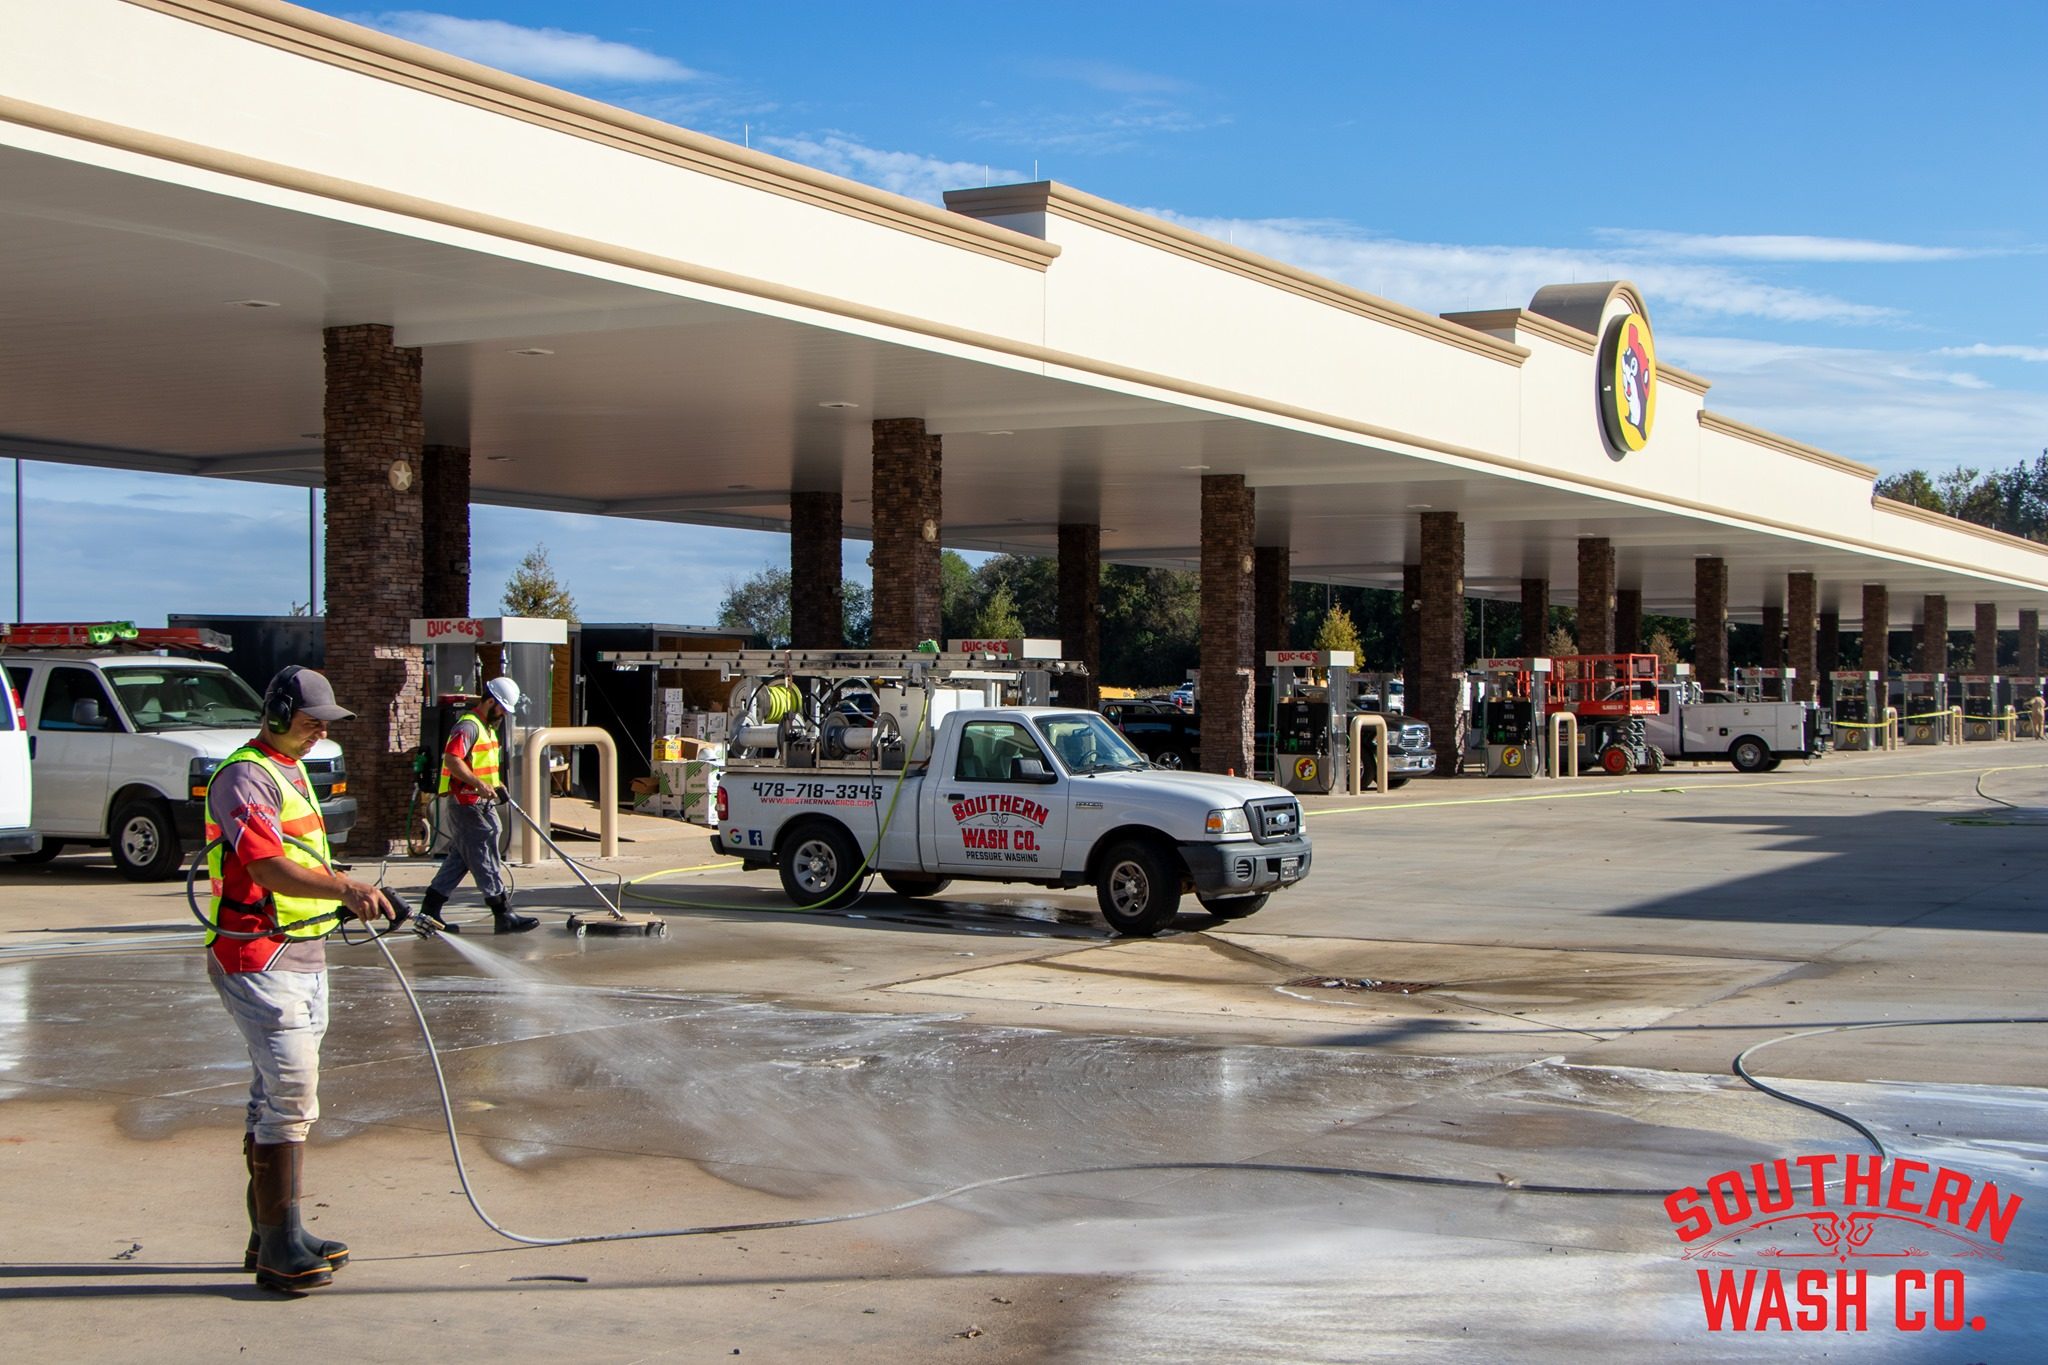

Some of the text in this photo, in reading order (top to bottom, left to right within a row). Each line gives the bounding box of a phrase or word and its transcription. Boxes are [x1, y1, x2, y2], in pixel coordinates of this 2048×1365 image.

[951, 794, 1049, 825] SOUTHERN
[961, 828, 1041, 851] WASH CO.
[966, 851, 1038, 863] PRESSURE WASHING
